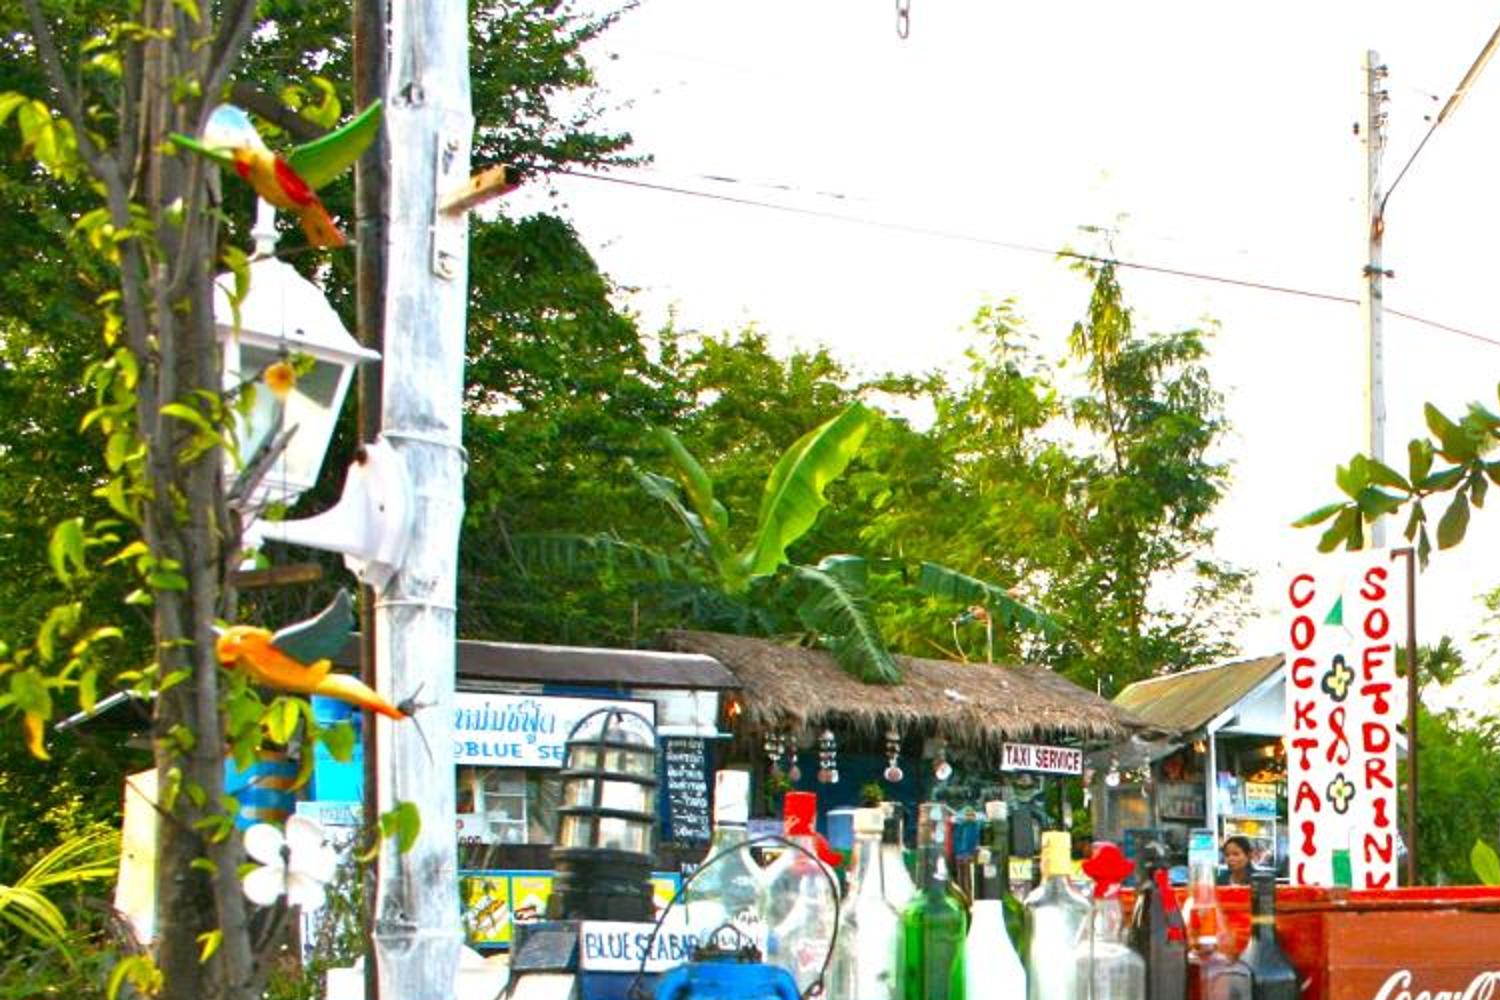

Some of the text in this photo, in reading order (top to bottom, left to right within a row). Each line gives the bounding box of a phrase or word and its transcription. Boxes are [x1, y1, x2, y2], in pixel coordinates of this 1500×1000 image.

[464, 741, 523, 758] BLUE
[1005, 744, 1081, 771] TAXI SERVICE
